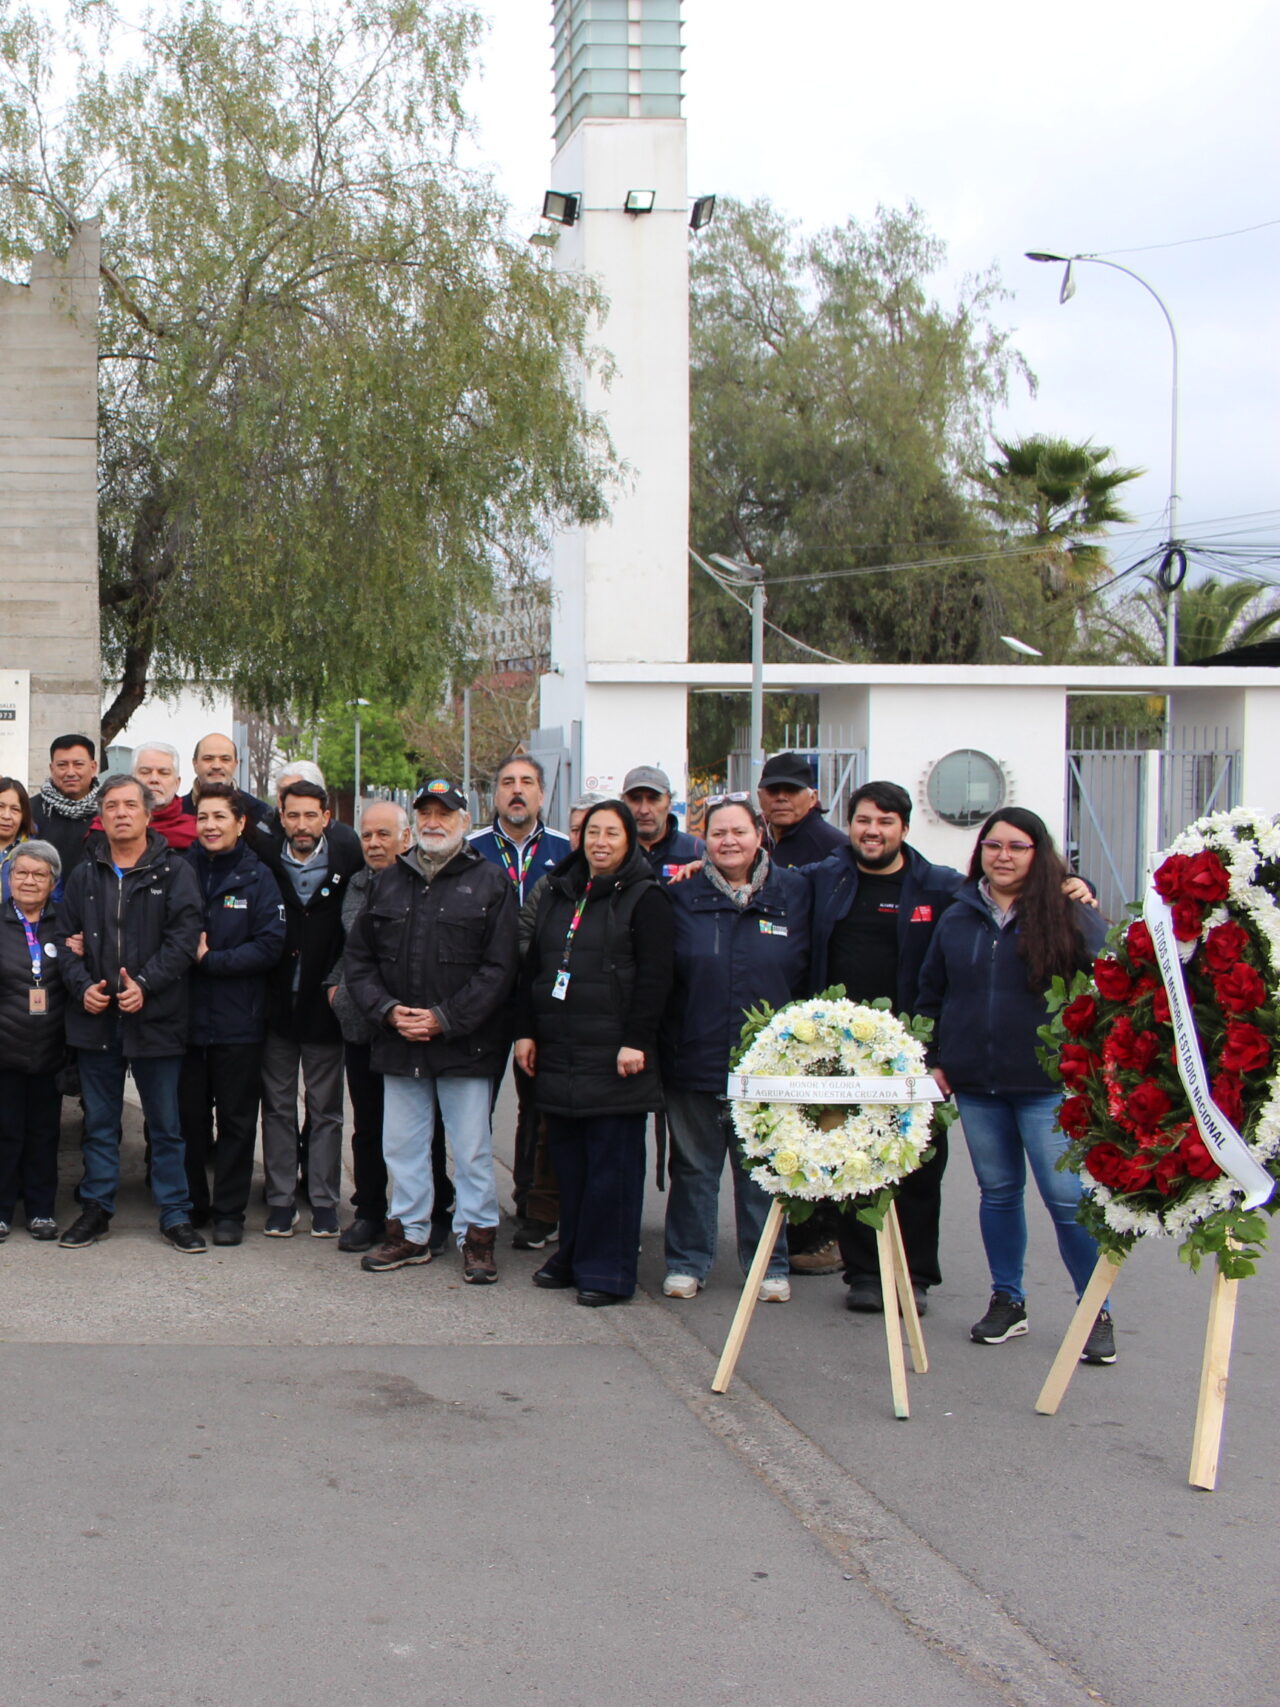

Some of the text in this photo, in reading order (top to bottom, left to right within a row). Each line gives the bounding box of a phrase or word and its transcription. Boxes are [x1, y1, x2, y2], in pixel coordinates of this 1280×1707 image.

[1153, 921, 1226, 1151] SITIOS DE MEMORIA ESTADIO NACIONAL
[789, 1080, 861, 1089] HONOR Y GLORIA
[754, 1089, 898, 1098] AGRUPACION NUESTRA CRUZADA
